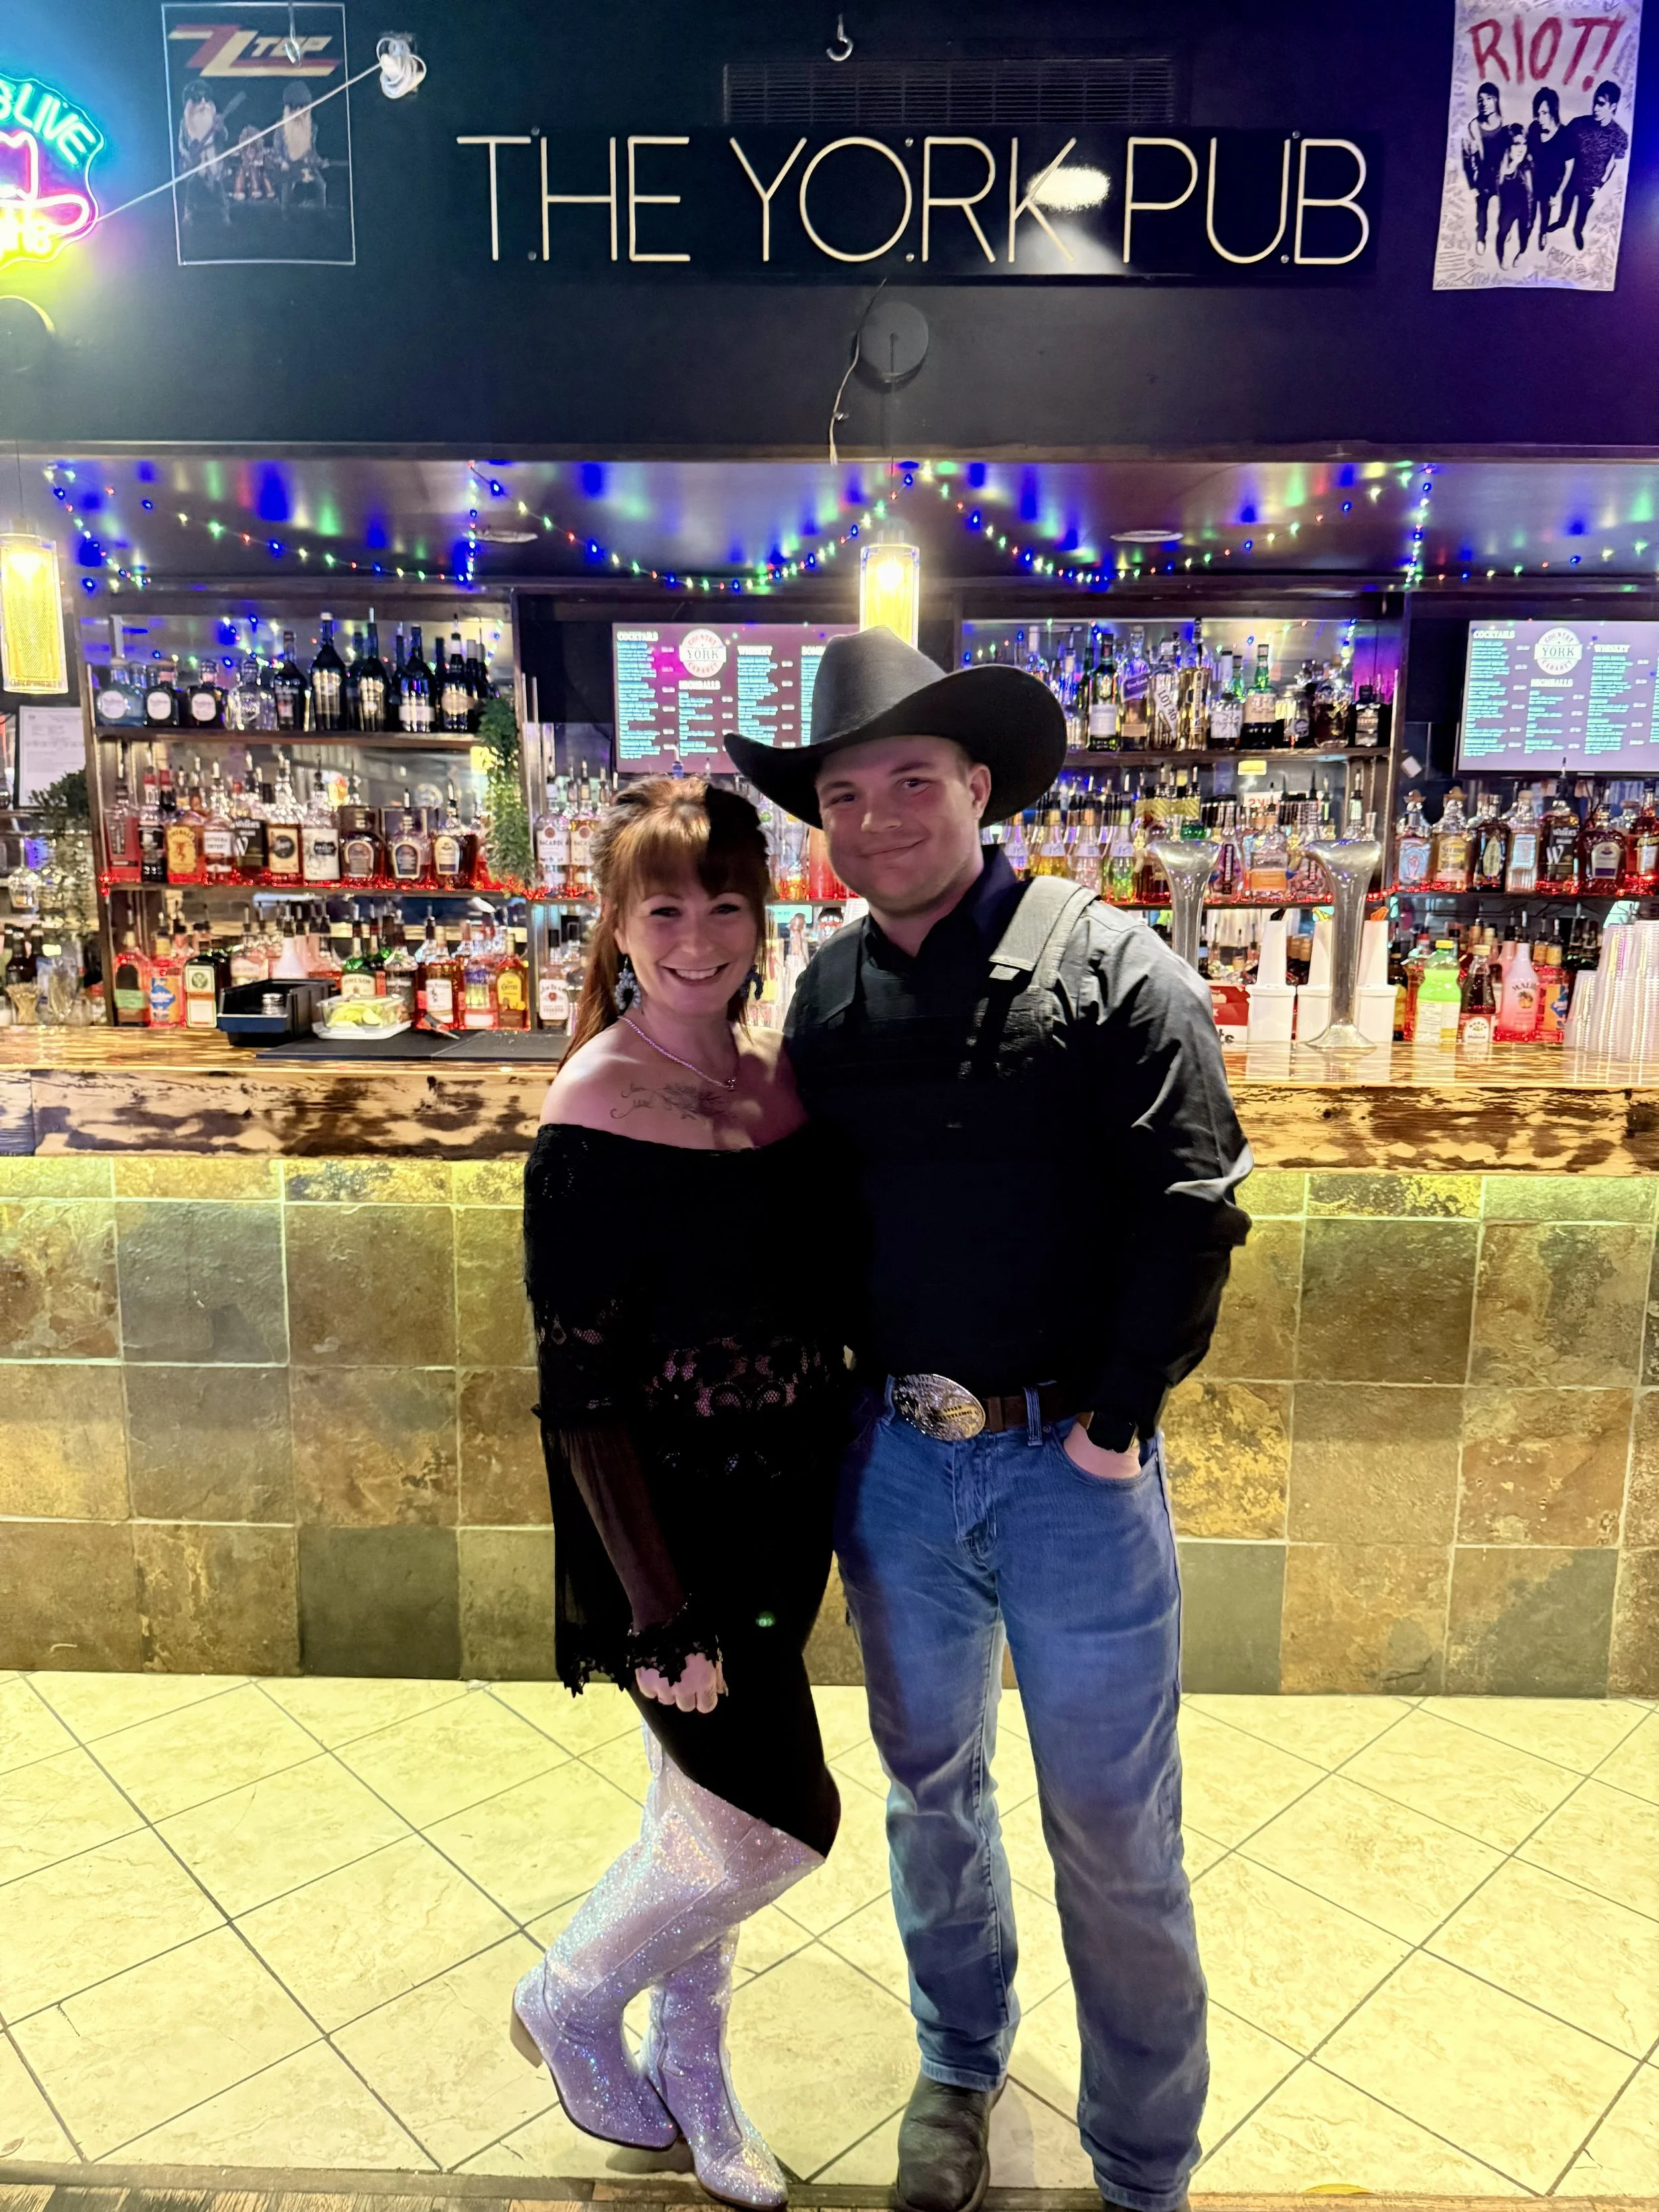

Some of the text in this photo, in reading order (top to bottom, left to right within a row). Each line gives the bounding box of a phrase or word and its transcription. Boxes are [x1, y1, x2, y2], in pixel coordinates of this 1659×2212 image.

[1467, 15, 1627, 92] RIOT!
[457, 135, 1370, 265] THE YORK PUB
[687, 649, 719, 660] YORK
[1542, 647, 1575, 657] YORK
[1157, 690, 1177, 721] LOT 40
